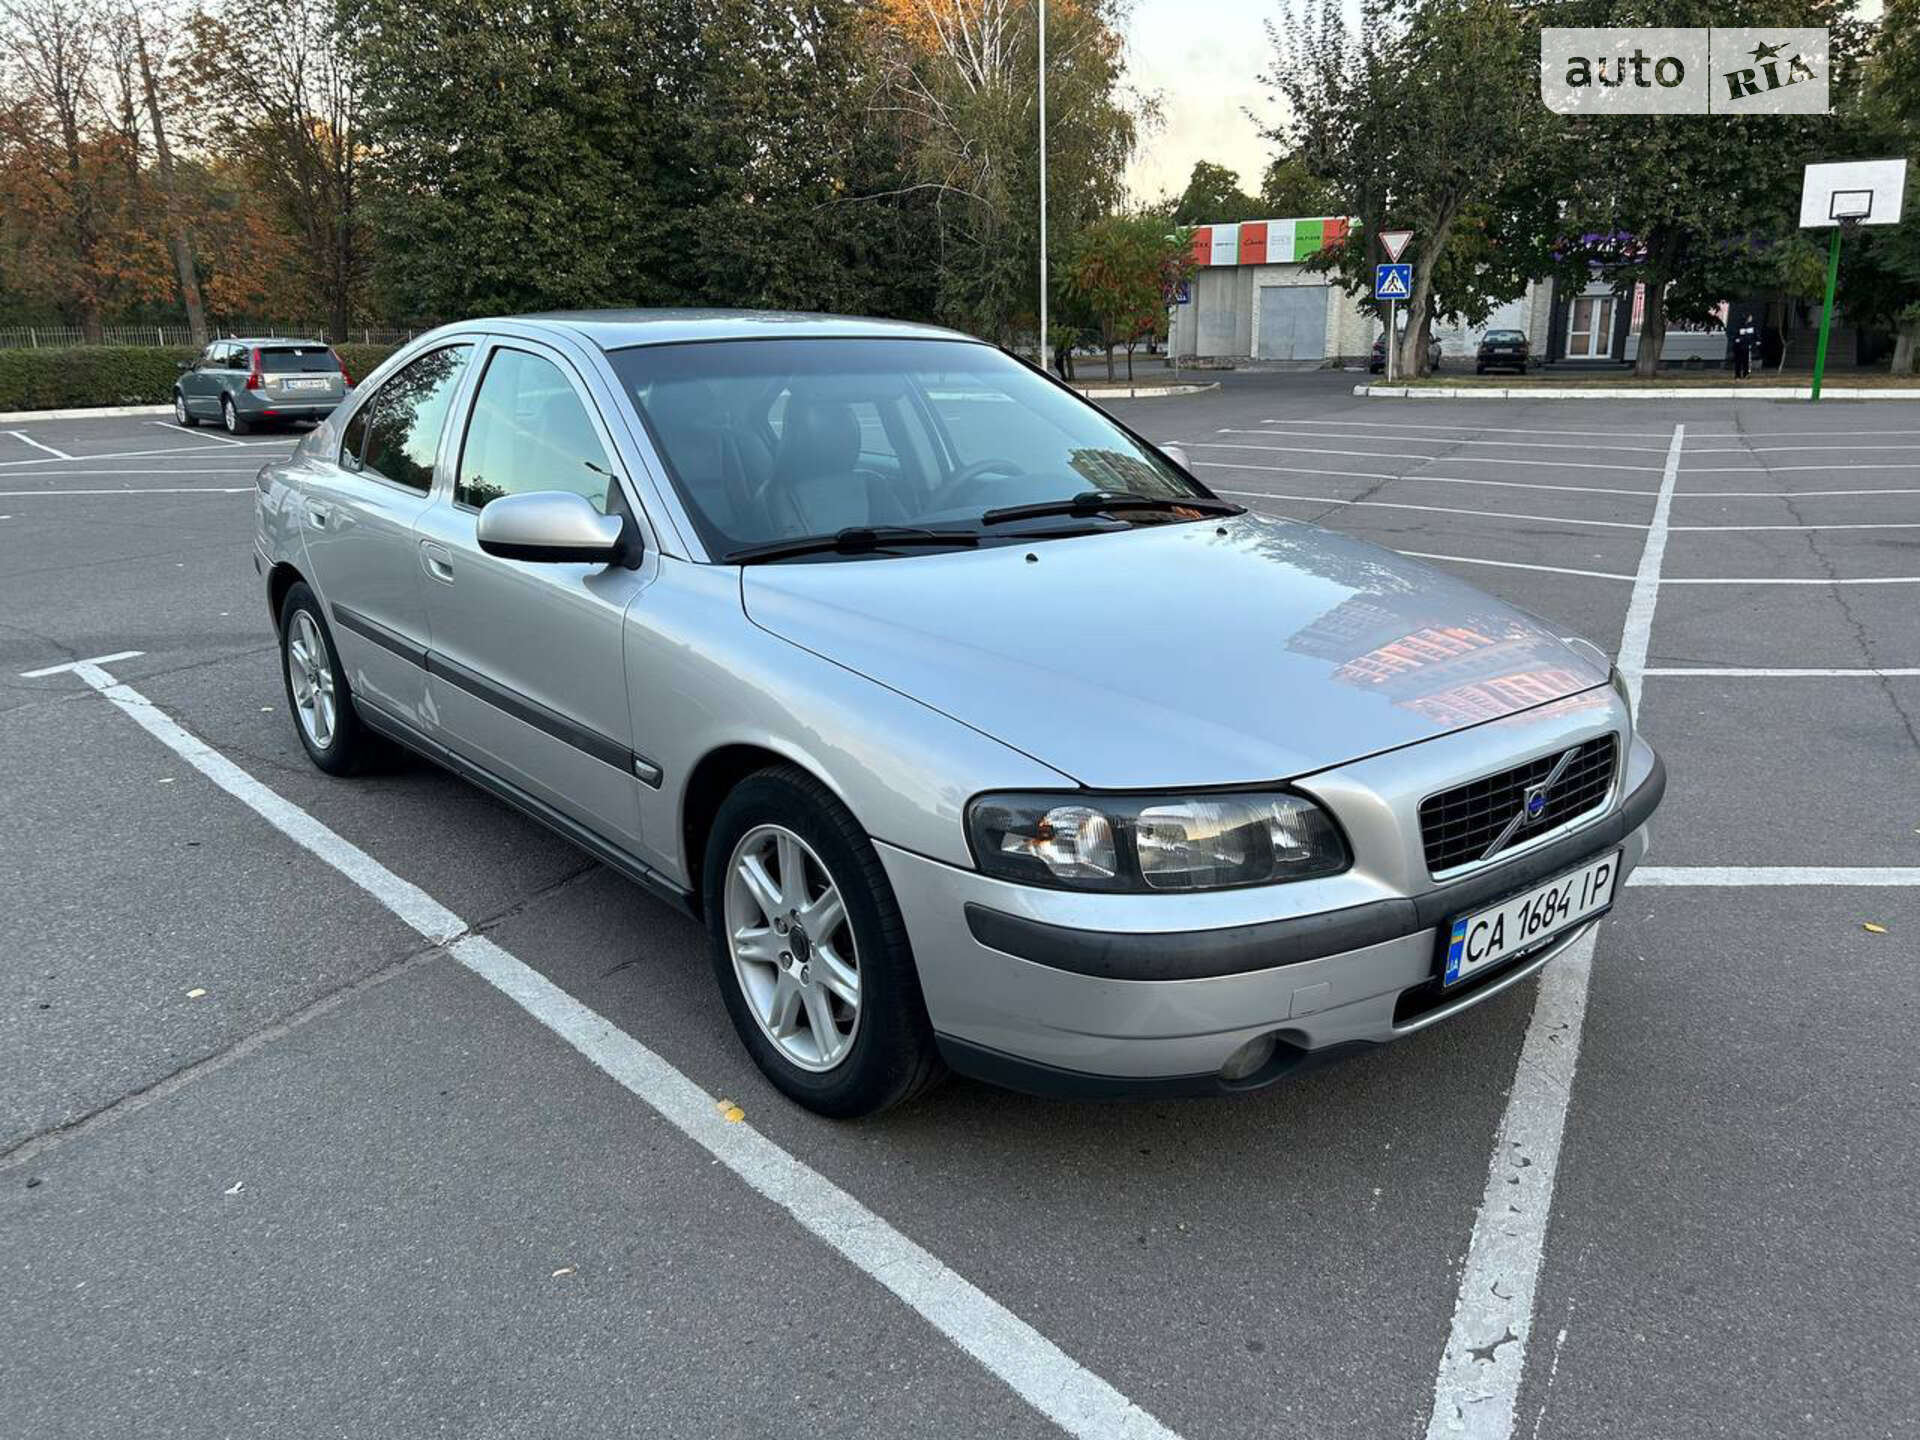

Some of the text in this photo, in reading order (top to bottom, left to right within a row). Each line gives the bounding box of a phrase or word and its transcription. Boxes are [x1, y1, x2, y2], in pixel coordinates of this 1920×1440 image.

[1466, 863, 1610, 962] CA 1684 IP
